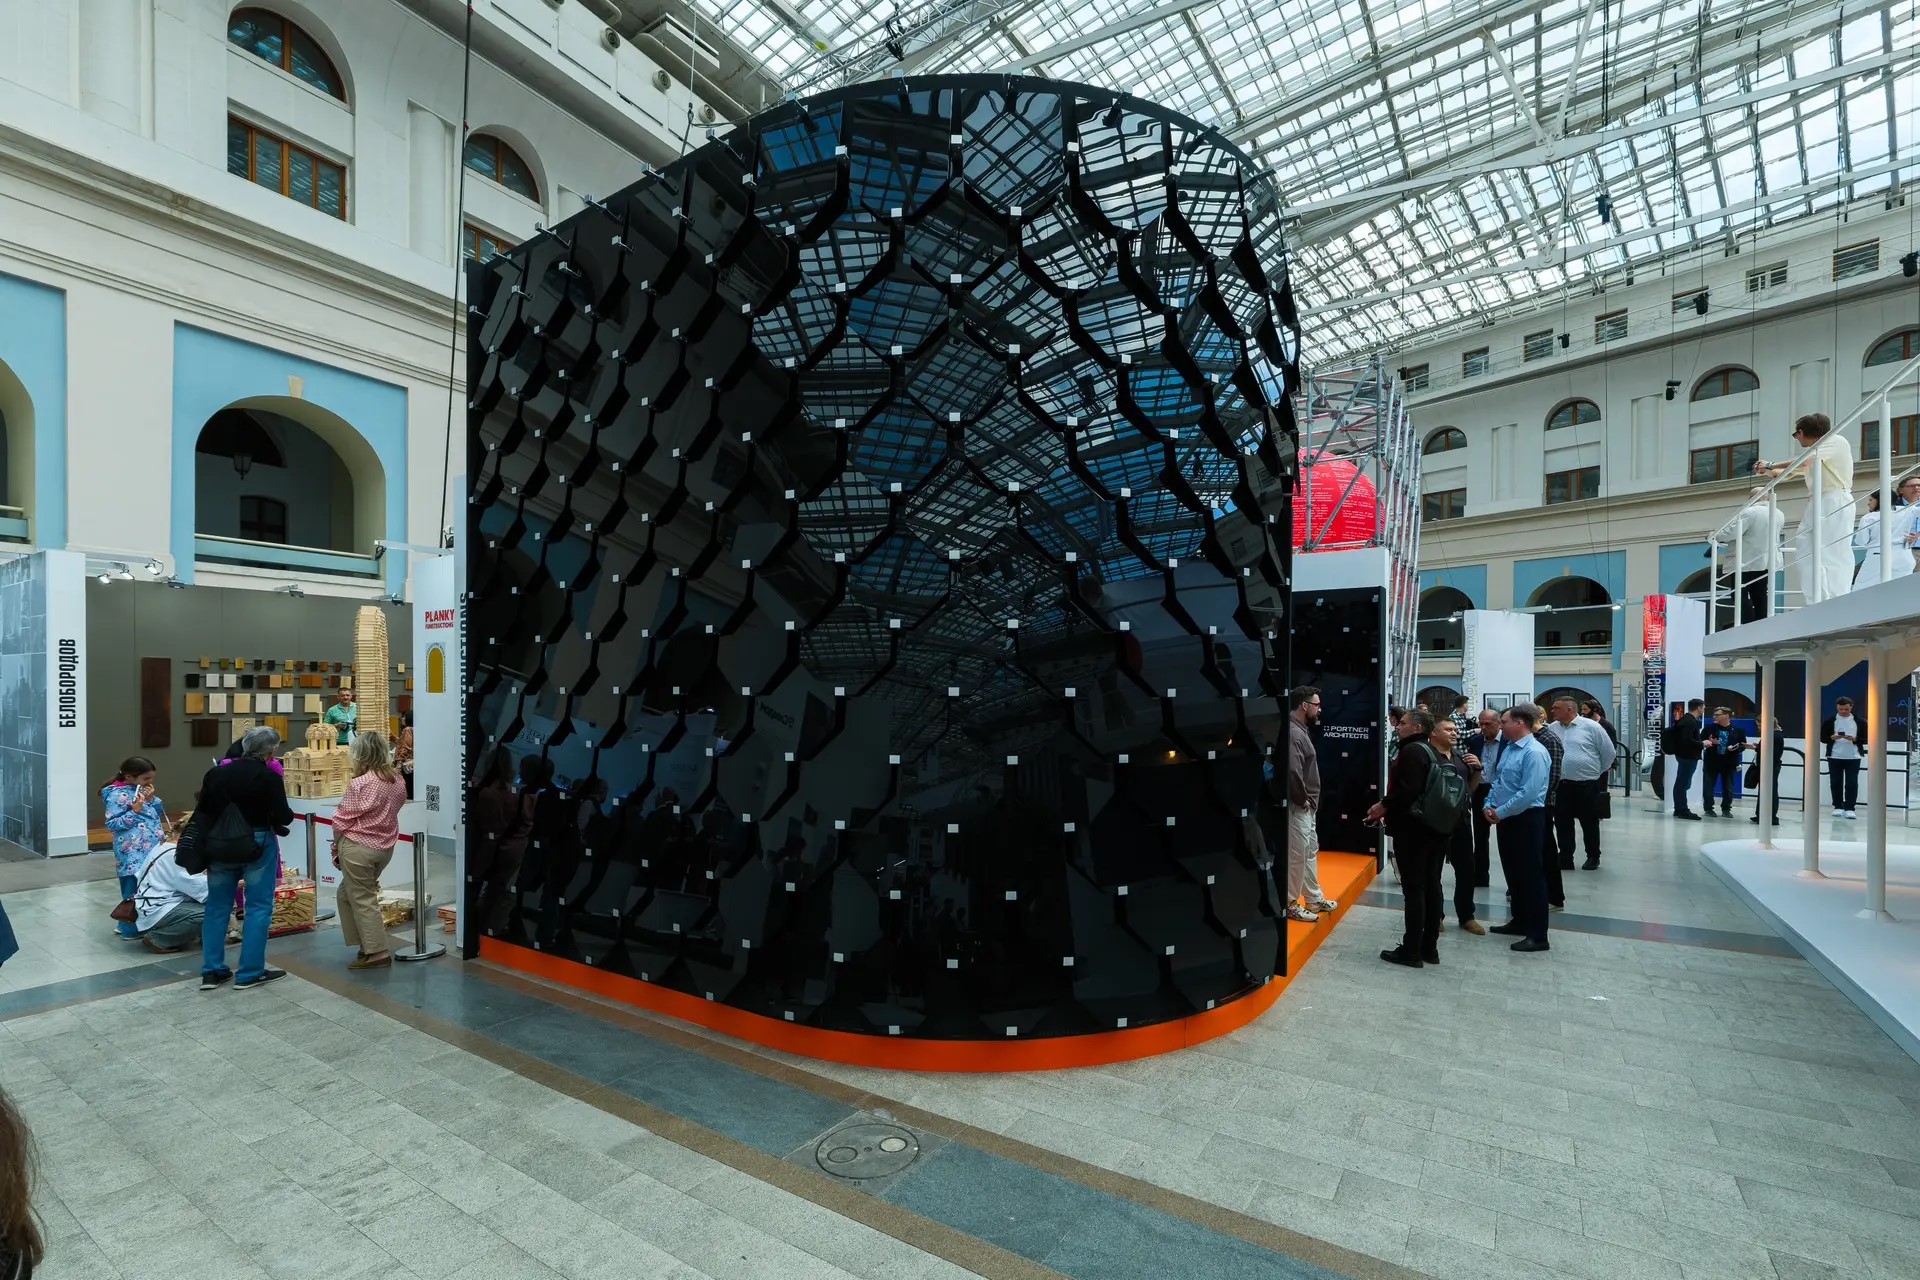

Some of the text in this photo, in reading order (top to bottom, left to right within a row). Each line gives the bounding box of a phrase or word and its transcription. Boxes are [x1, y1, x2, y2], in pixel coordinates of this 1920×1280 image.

[425, 609, 455, 622] PLANKY
[59, 639, 79, 727] БЕЛОБОРОДОВ
[1647, 624, 1661, 758] ИЛЛЮЗИЯ СОВЕРШЕНСТВА
